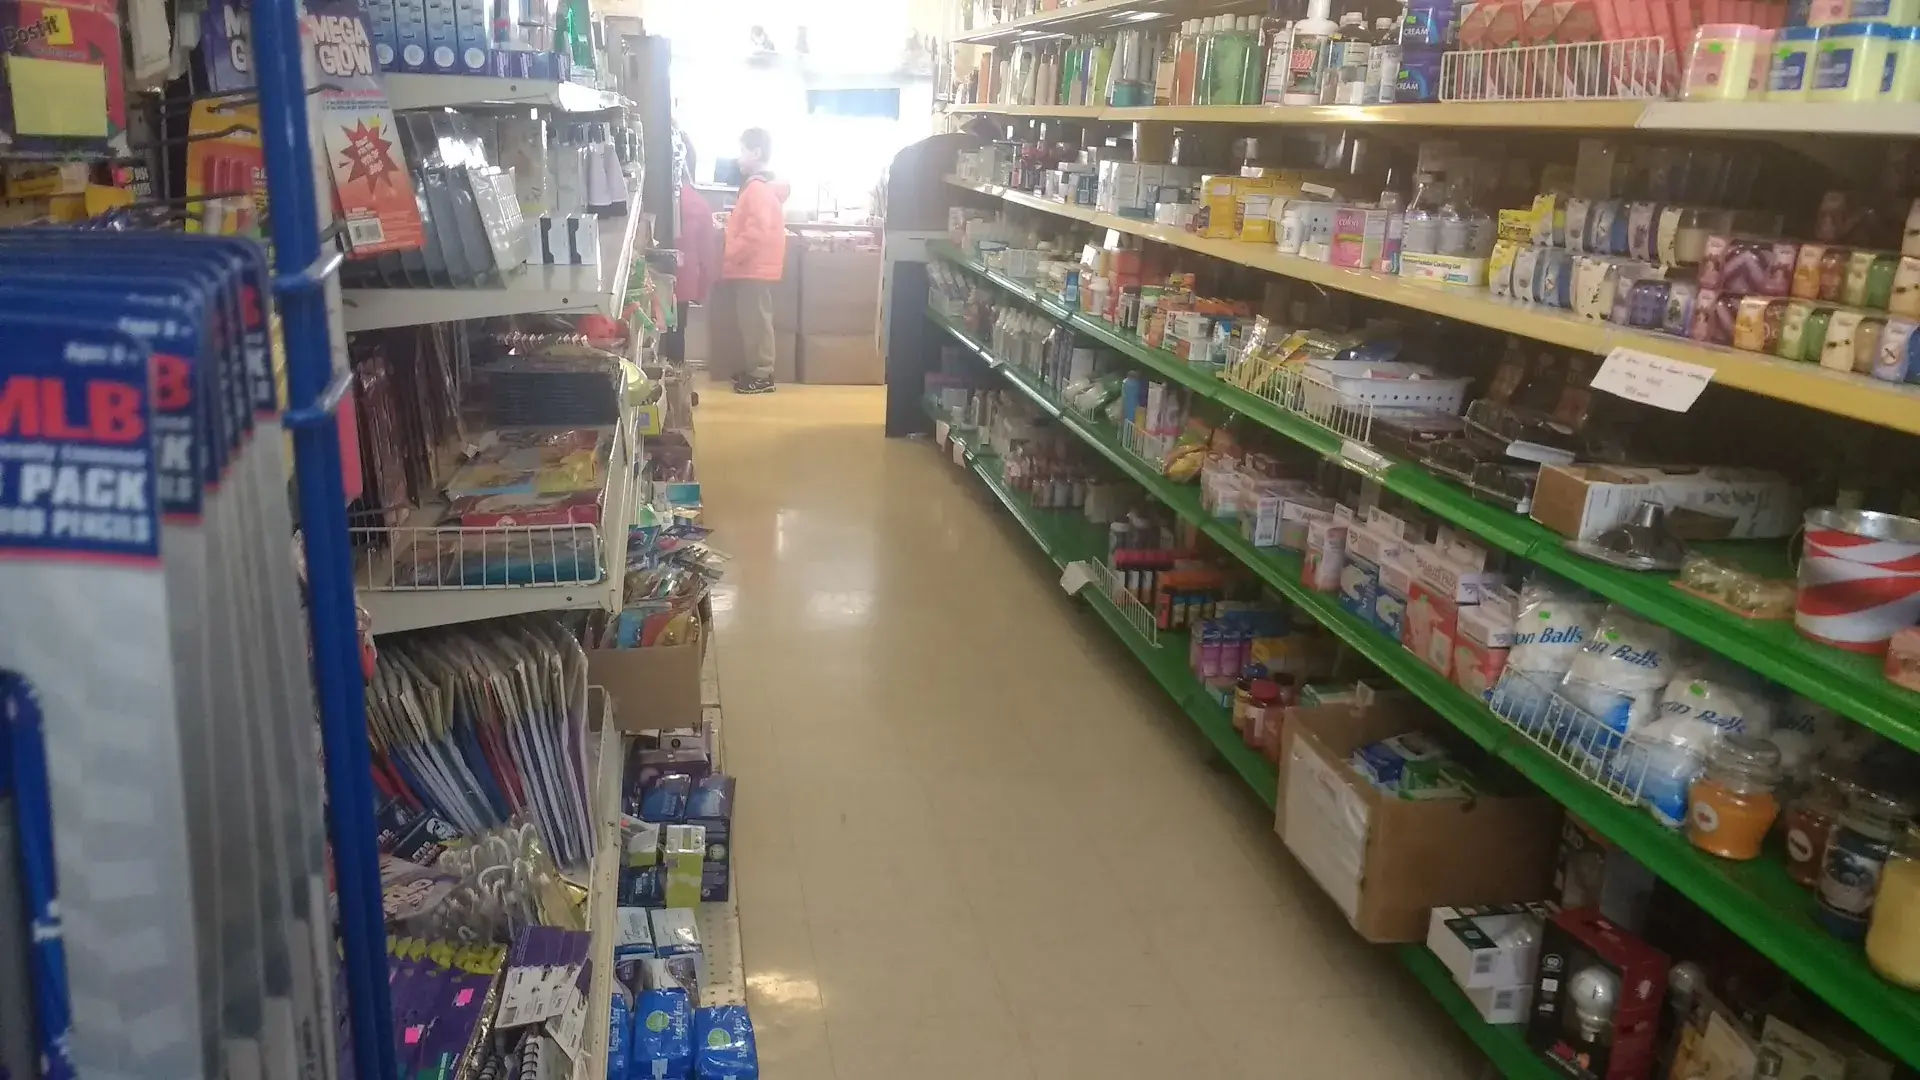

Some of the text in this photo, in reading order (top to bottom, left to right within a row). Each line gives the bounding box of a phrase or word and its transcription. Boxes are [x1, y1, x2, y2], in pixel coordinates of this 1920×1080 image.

[309, 14, 371, 47] MEGA
[1402, 27, 1429, 36] CREAM
[318, 45, 373, 77] GLOW
[0, 374, 145, 444] MLB
[20, 464, 149, 510] PACK
[1538, 625, 1584, 644] Balls
[1611, 644, 1663, 670] Balls
